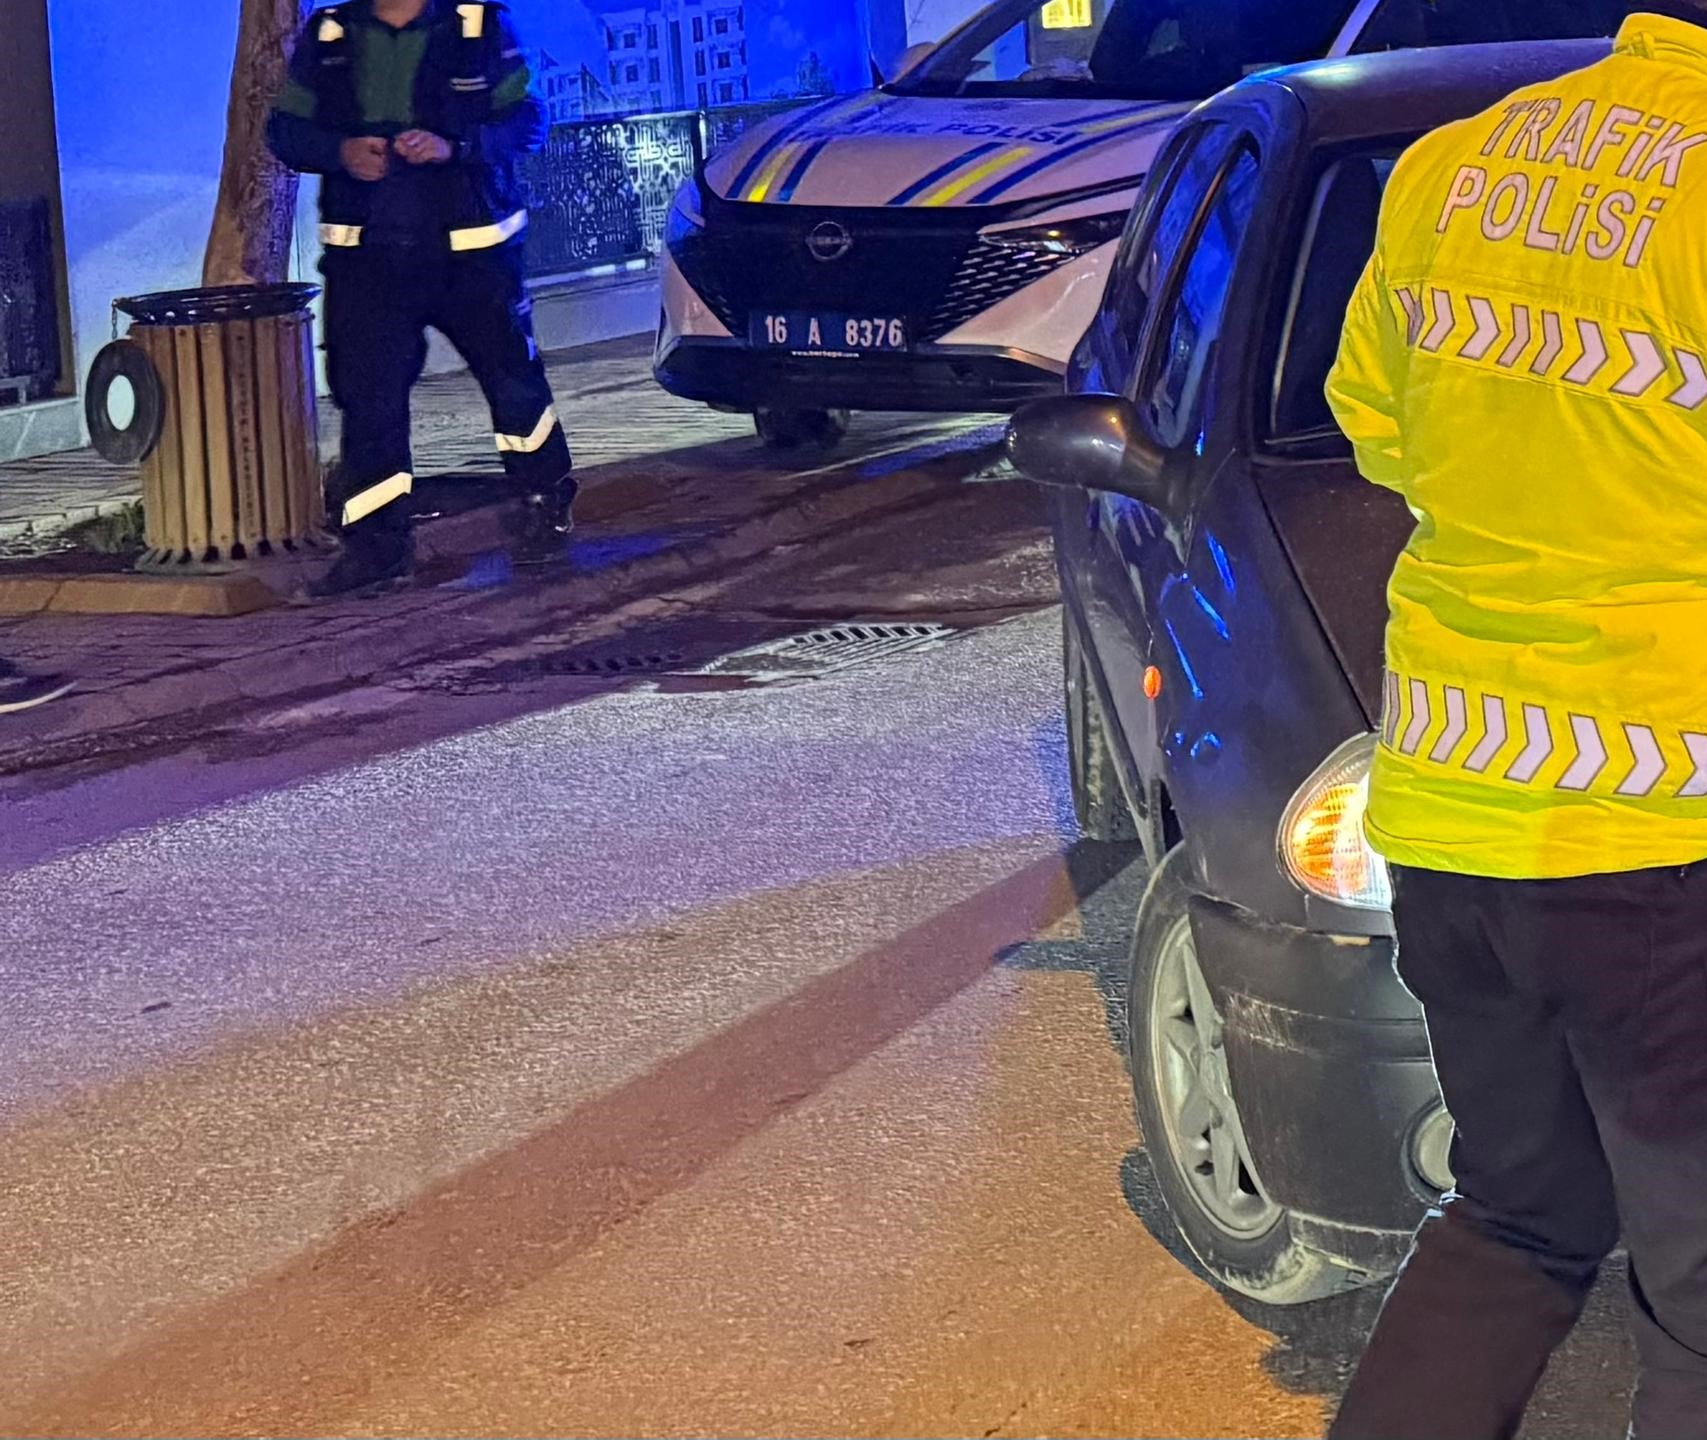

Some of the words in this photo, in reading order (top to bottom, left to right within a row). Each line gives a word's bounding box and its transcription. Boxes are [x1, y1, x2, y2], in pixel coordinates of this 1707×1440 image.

[1435, 164, 1668, 269] POLİSİ
[764, 314, 788, 344] 16
[807, 317, 822, 346] A
[845, 318, 903, 347] 8376
